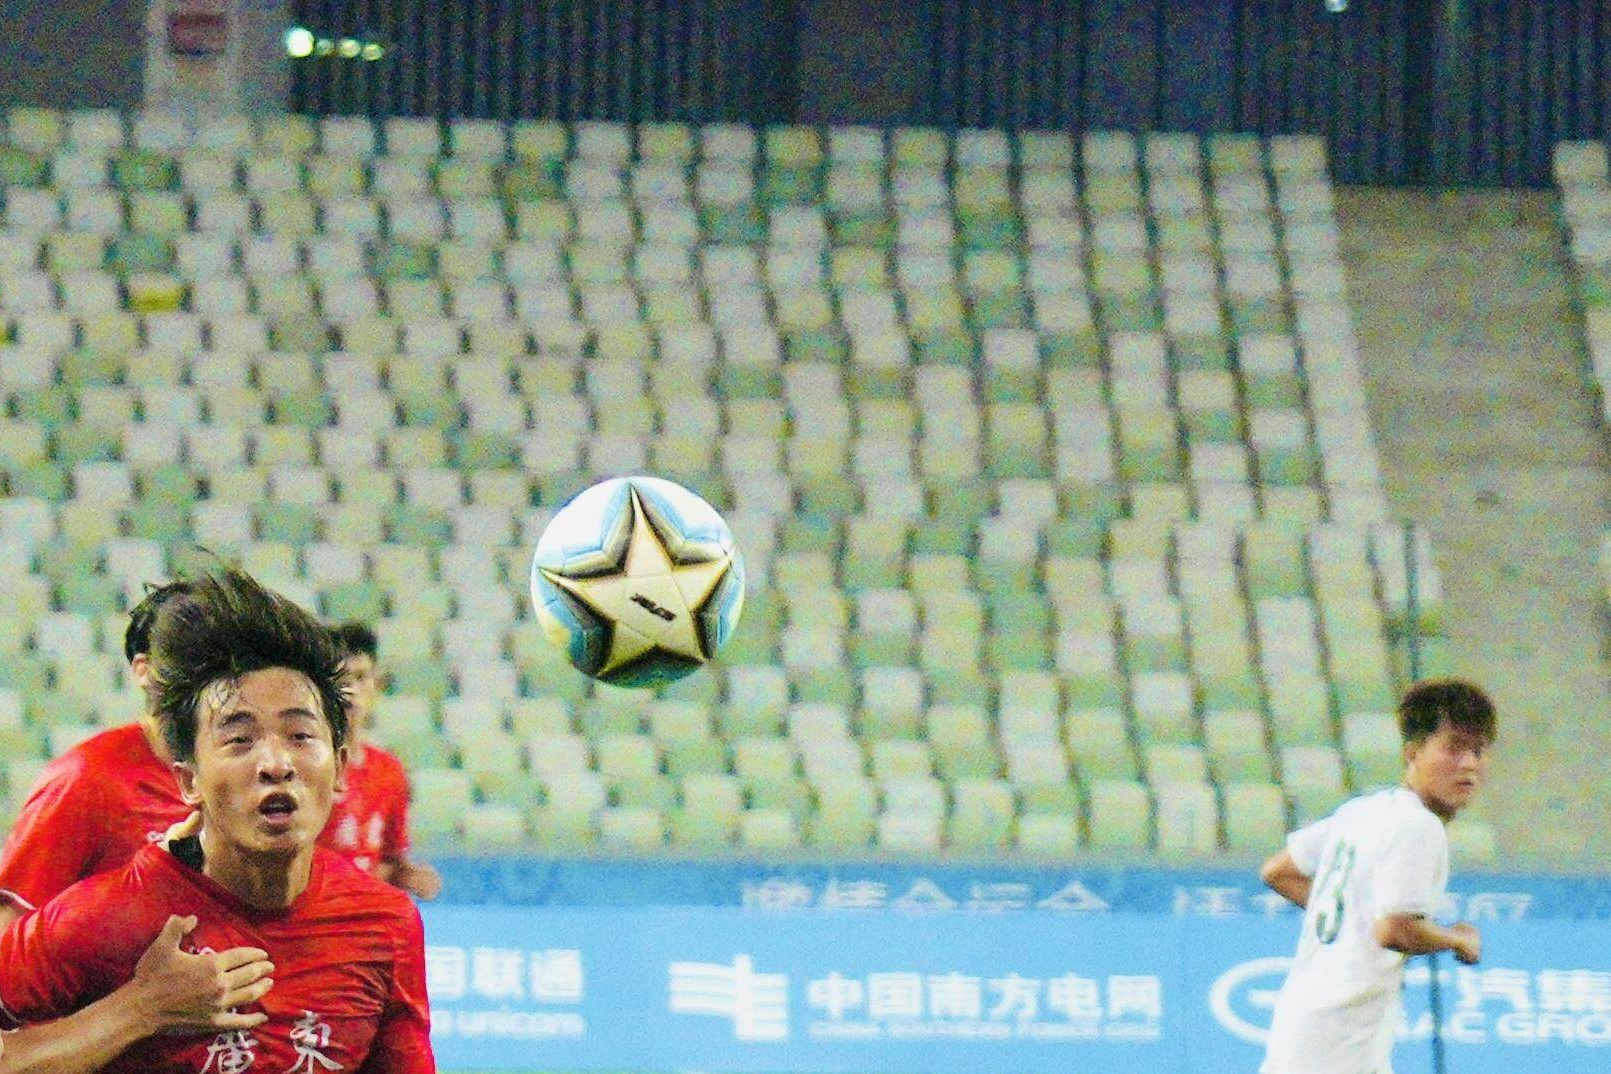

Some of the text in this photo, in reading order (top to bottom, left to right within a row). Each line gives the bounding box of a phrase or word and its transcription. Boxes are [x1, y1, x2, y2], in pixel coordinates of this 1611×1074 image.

[806, 970, 1162, 1026] 中国南方电网
